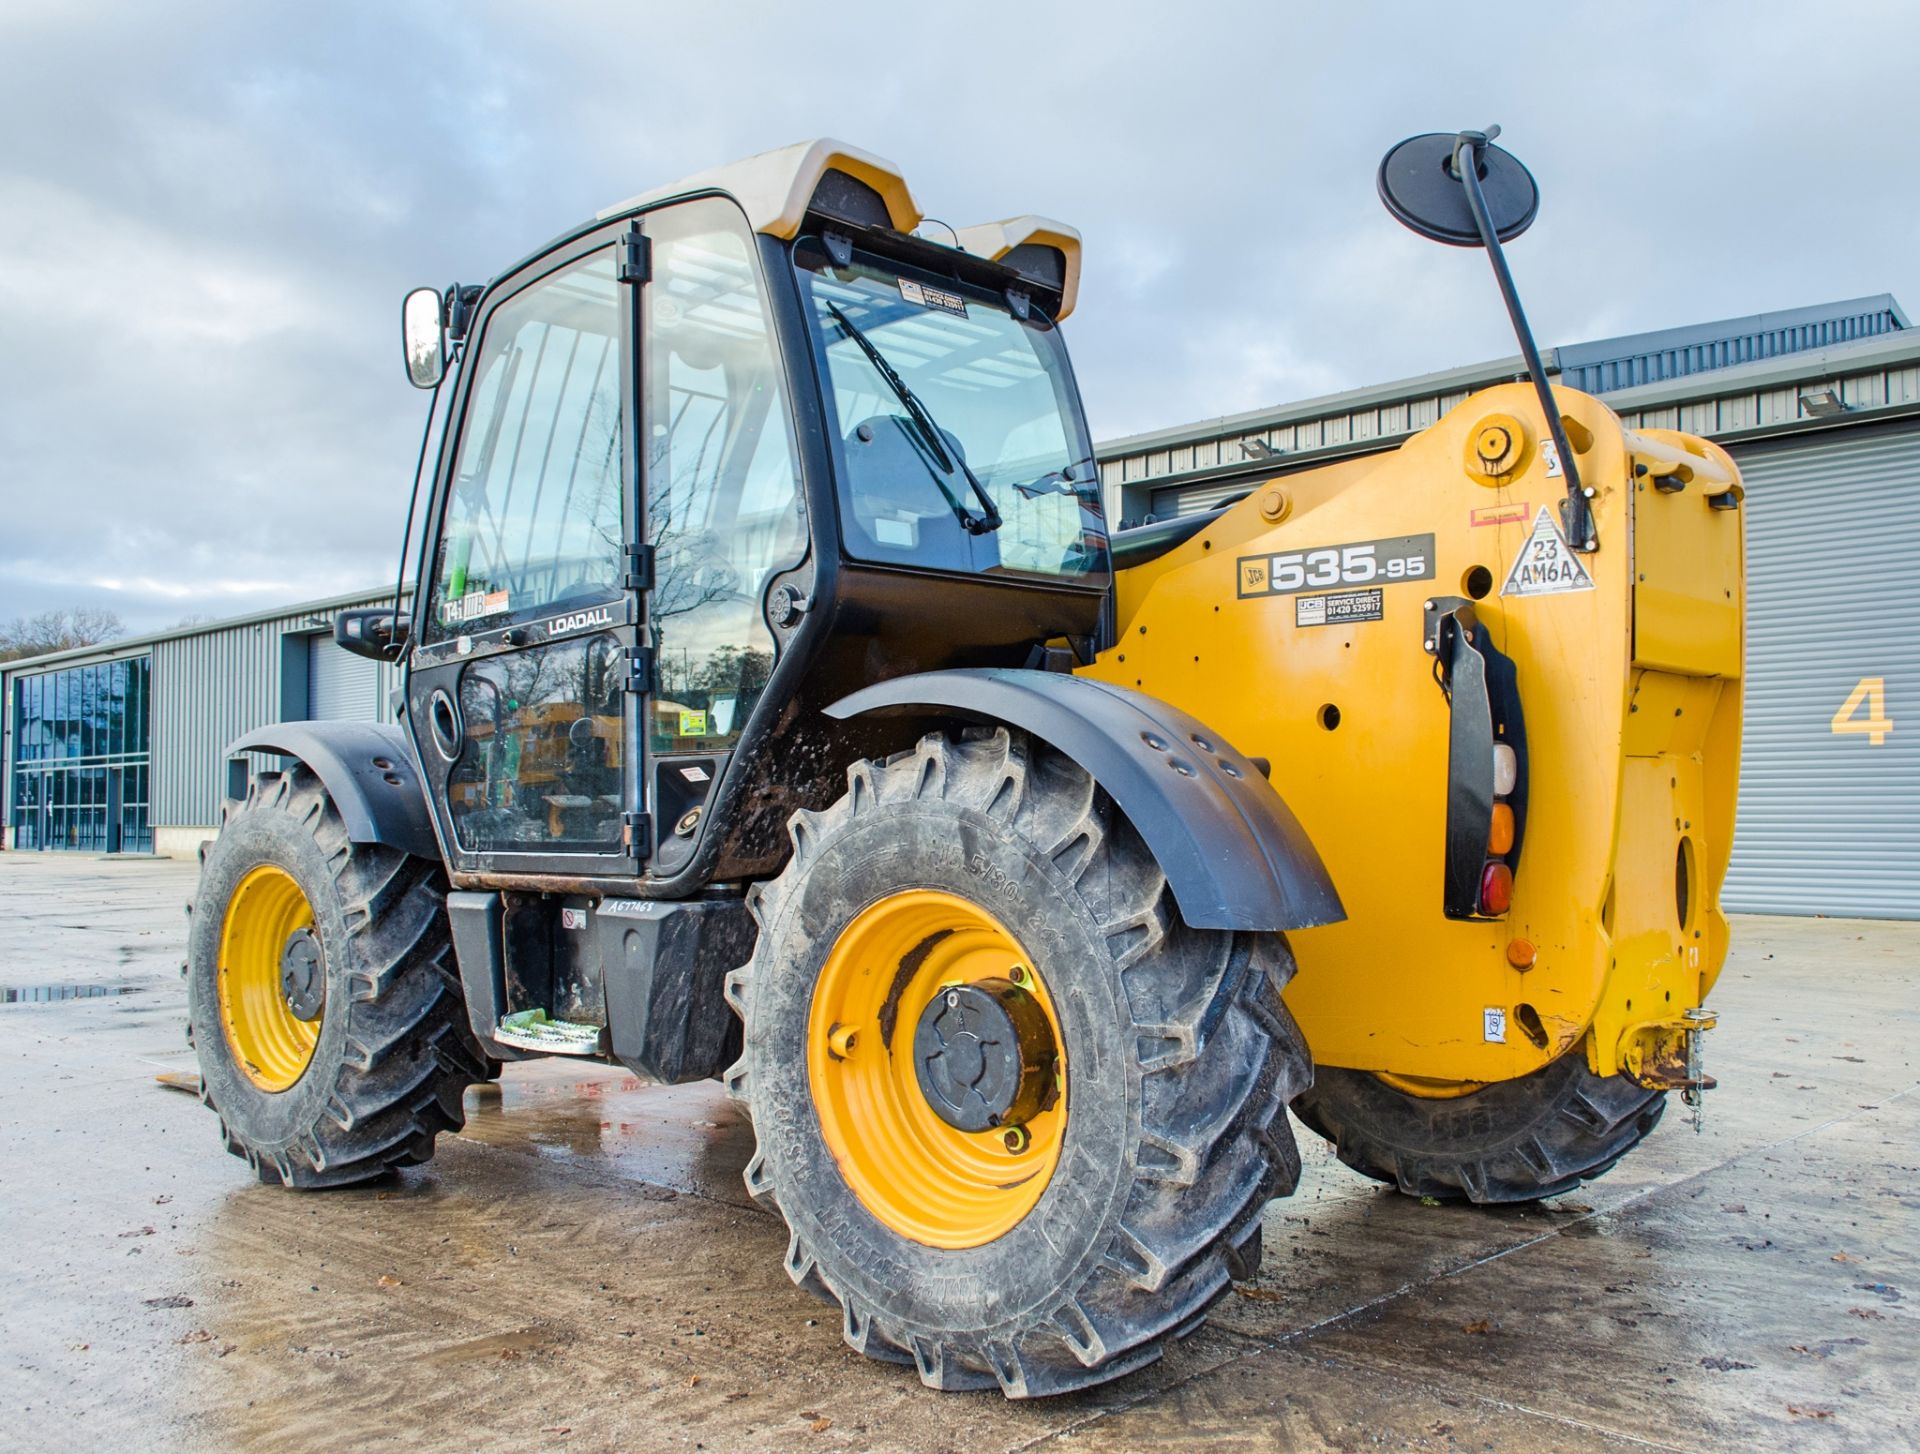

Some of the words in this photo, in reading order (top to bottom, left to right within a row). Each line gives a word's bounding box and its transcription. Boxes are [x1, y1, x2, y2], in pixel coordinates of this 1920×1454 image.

[1533, 538, 1558, 561] 23
[1246, 568, 1264, 586] JCB
[1521, 560, 1573, 585] AM6A
[1298, 600, 1323, 610] JCB
[1326, 597, 1355, 607] SERVICE
[1355, 595, 1381, 604] DIRECT
[1327, 605, 1351, 615] 01420
[1352, 602, 1381, 613] 525917
[549, 608, 613, 635] LOADALL
[1831, 677, 1893, 745] 4
